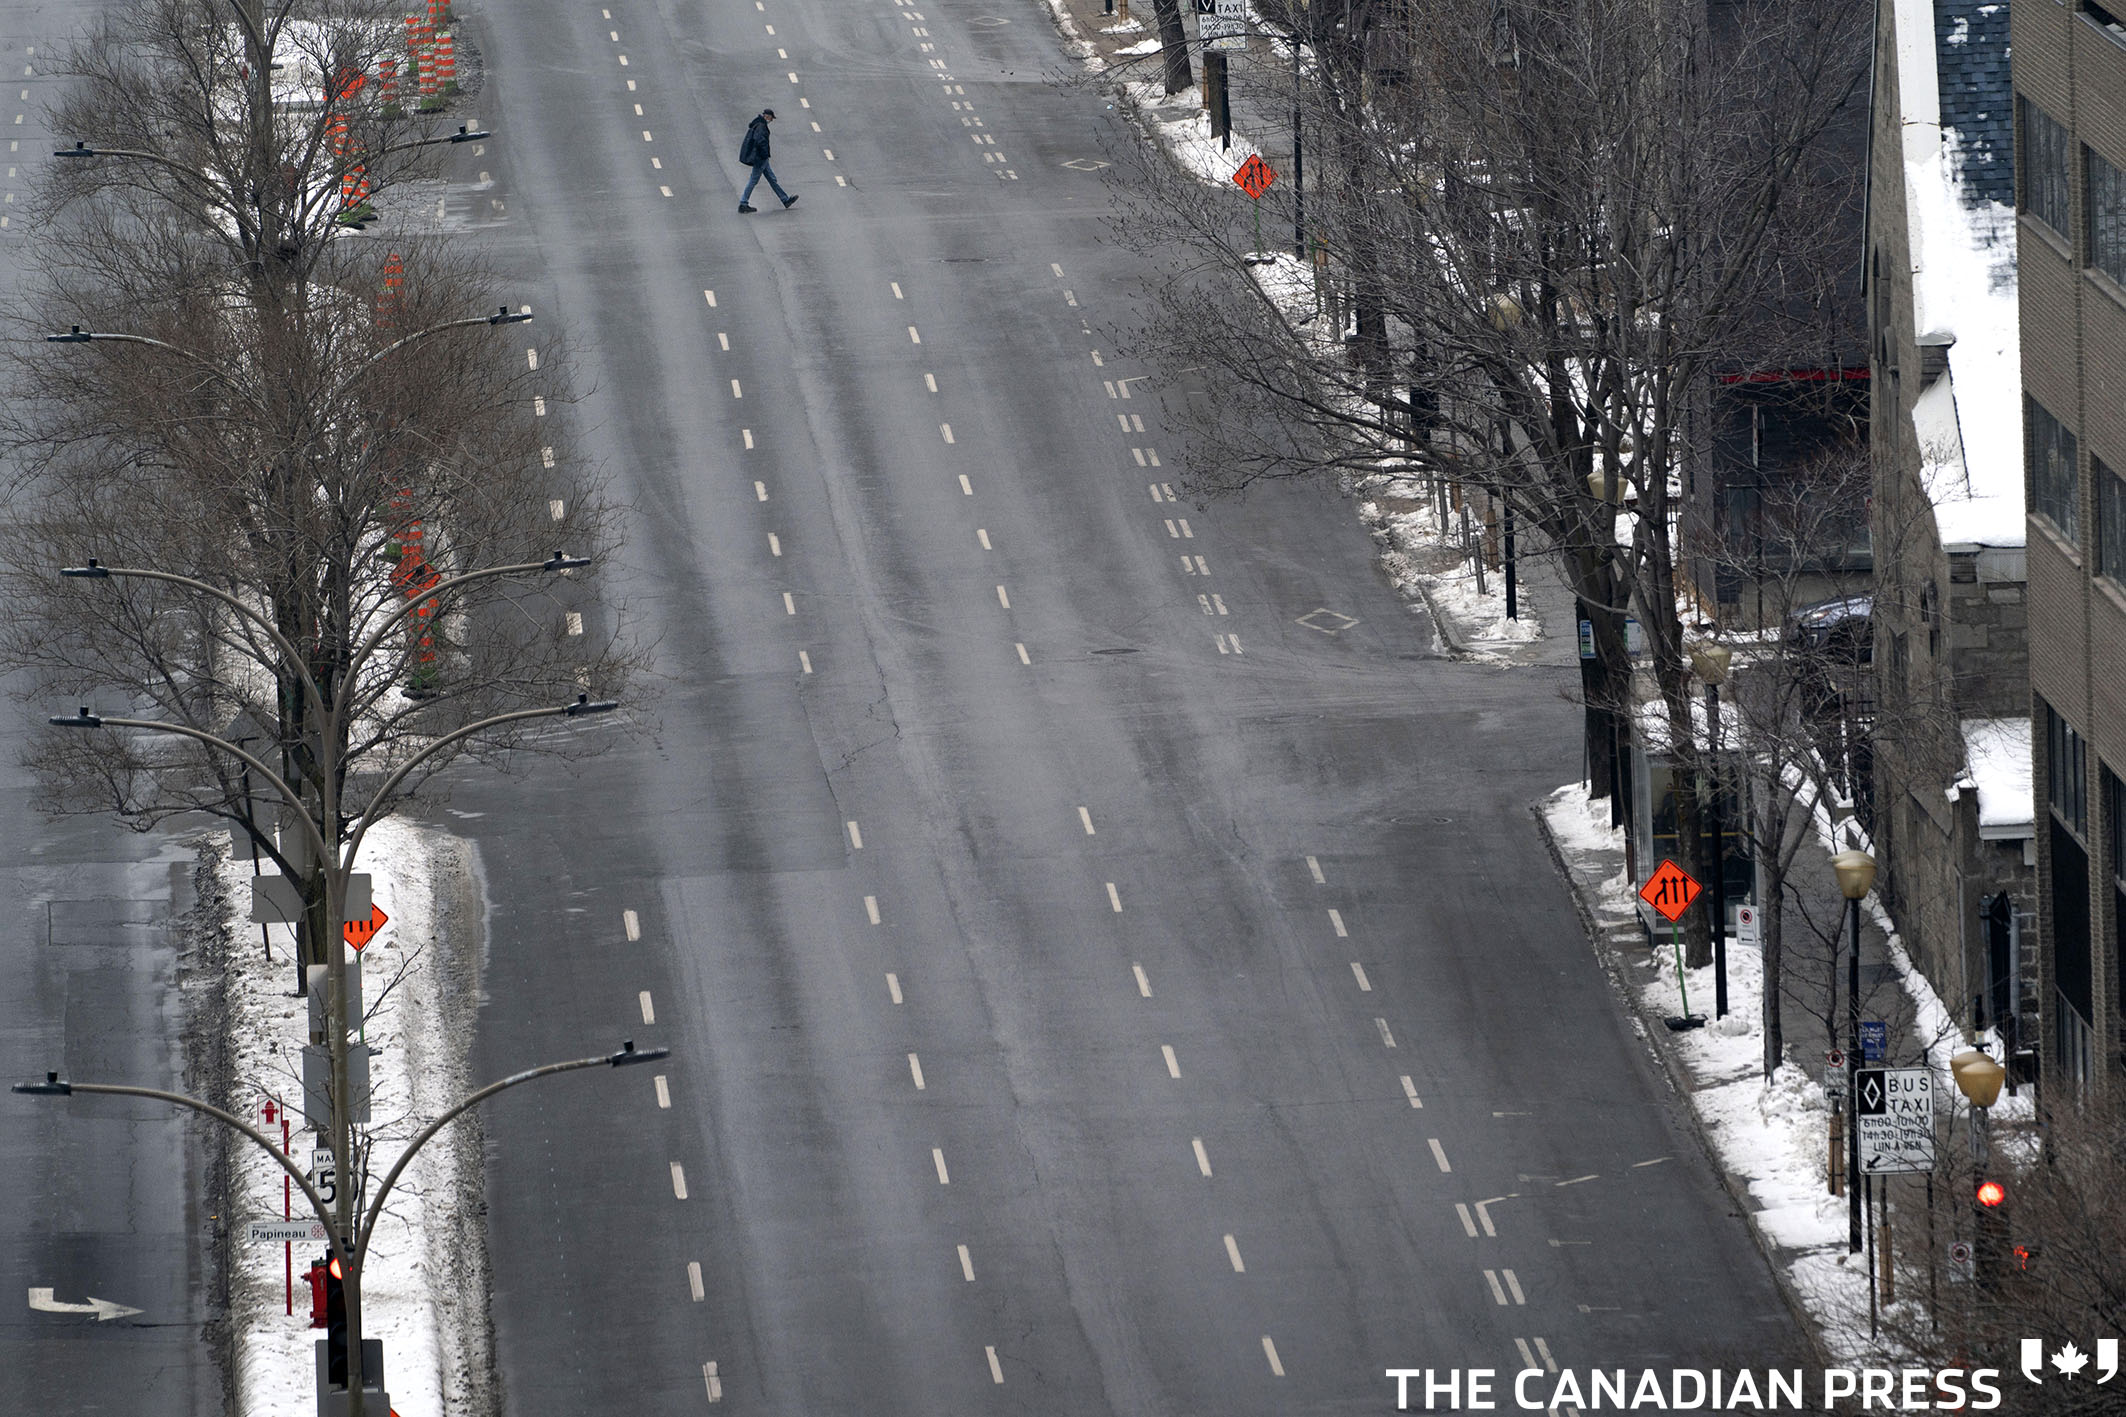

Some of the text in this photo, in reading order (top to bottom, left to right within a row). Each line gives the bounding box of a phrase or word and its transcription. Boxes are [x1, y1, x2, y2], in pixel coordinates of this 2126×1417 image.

[1218, 4, 1243, 13] TAXI
[1889, 1077, 1929, 1093] BUS
[1891, 1098, 1930, 1113] TAXI
[252, 1229, 306, 1241] Papineau
